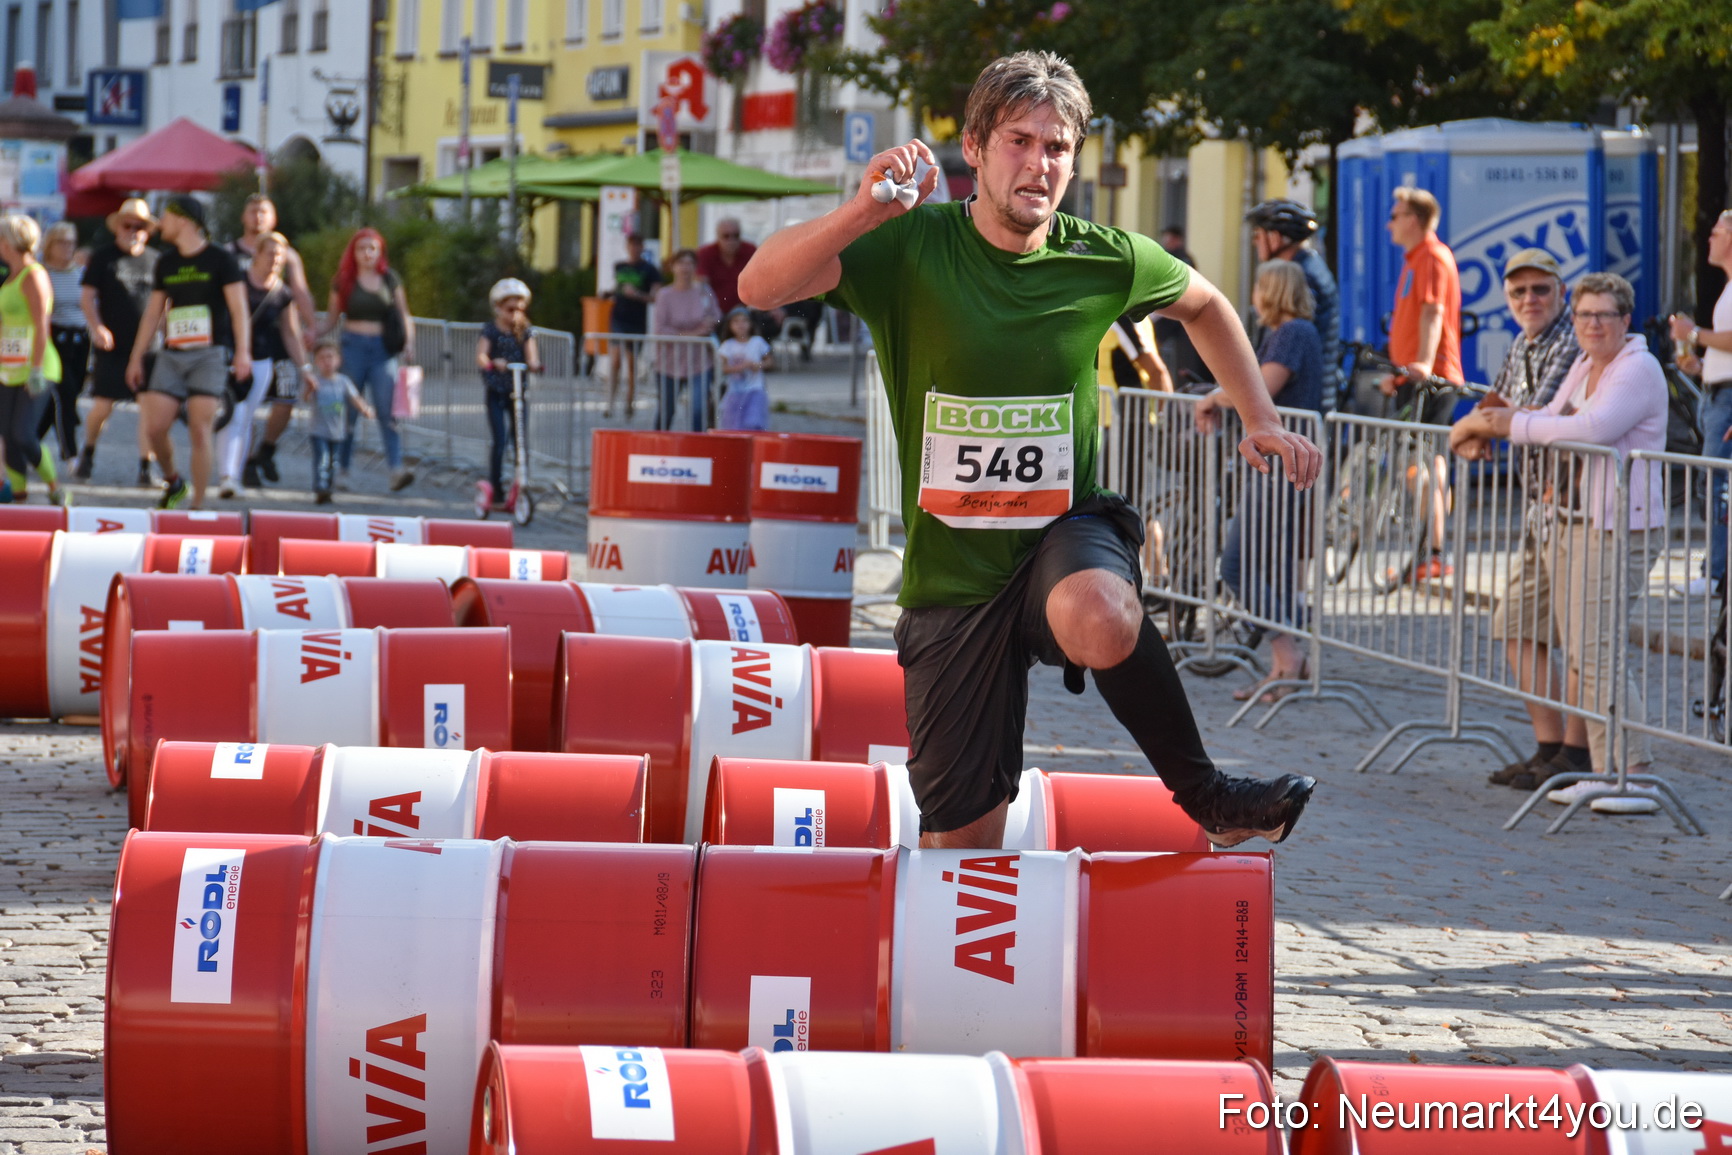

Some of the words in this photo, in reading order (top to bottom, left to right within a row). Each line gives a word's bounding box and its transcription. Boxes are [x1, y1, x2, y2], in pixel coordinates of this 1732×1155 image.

[937, 403, 1062, 433] BOCK
[955, 445, 1044, 483] 548
[956, 495, 1028, 513] Benjamin
[795, 807, 813, 846] DL
[814, 808, 824, 847] nergie
[226, 865, 240, 910] energie
[1235, 900, 1249, 963] 12414-B&B
[797, 1010, 808, 1052] ergie
